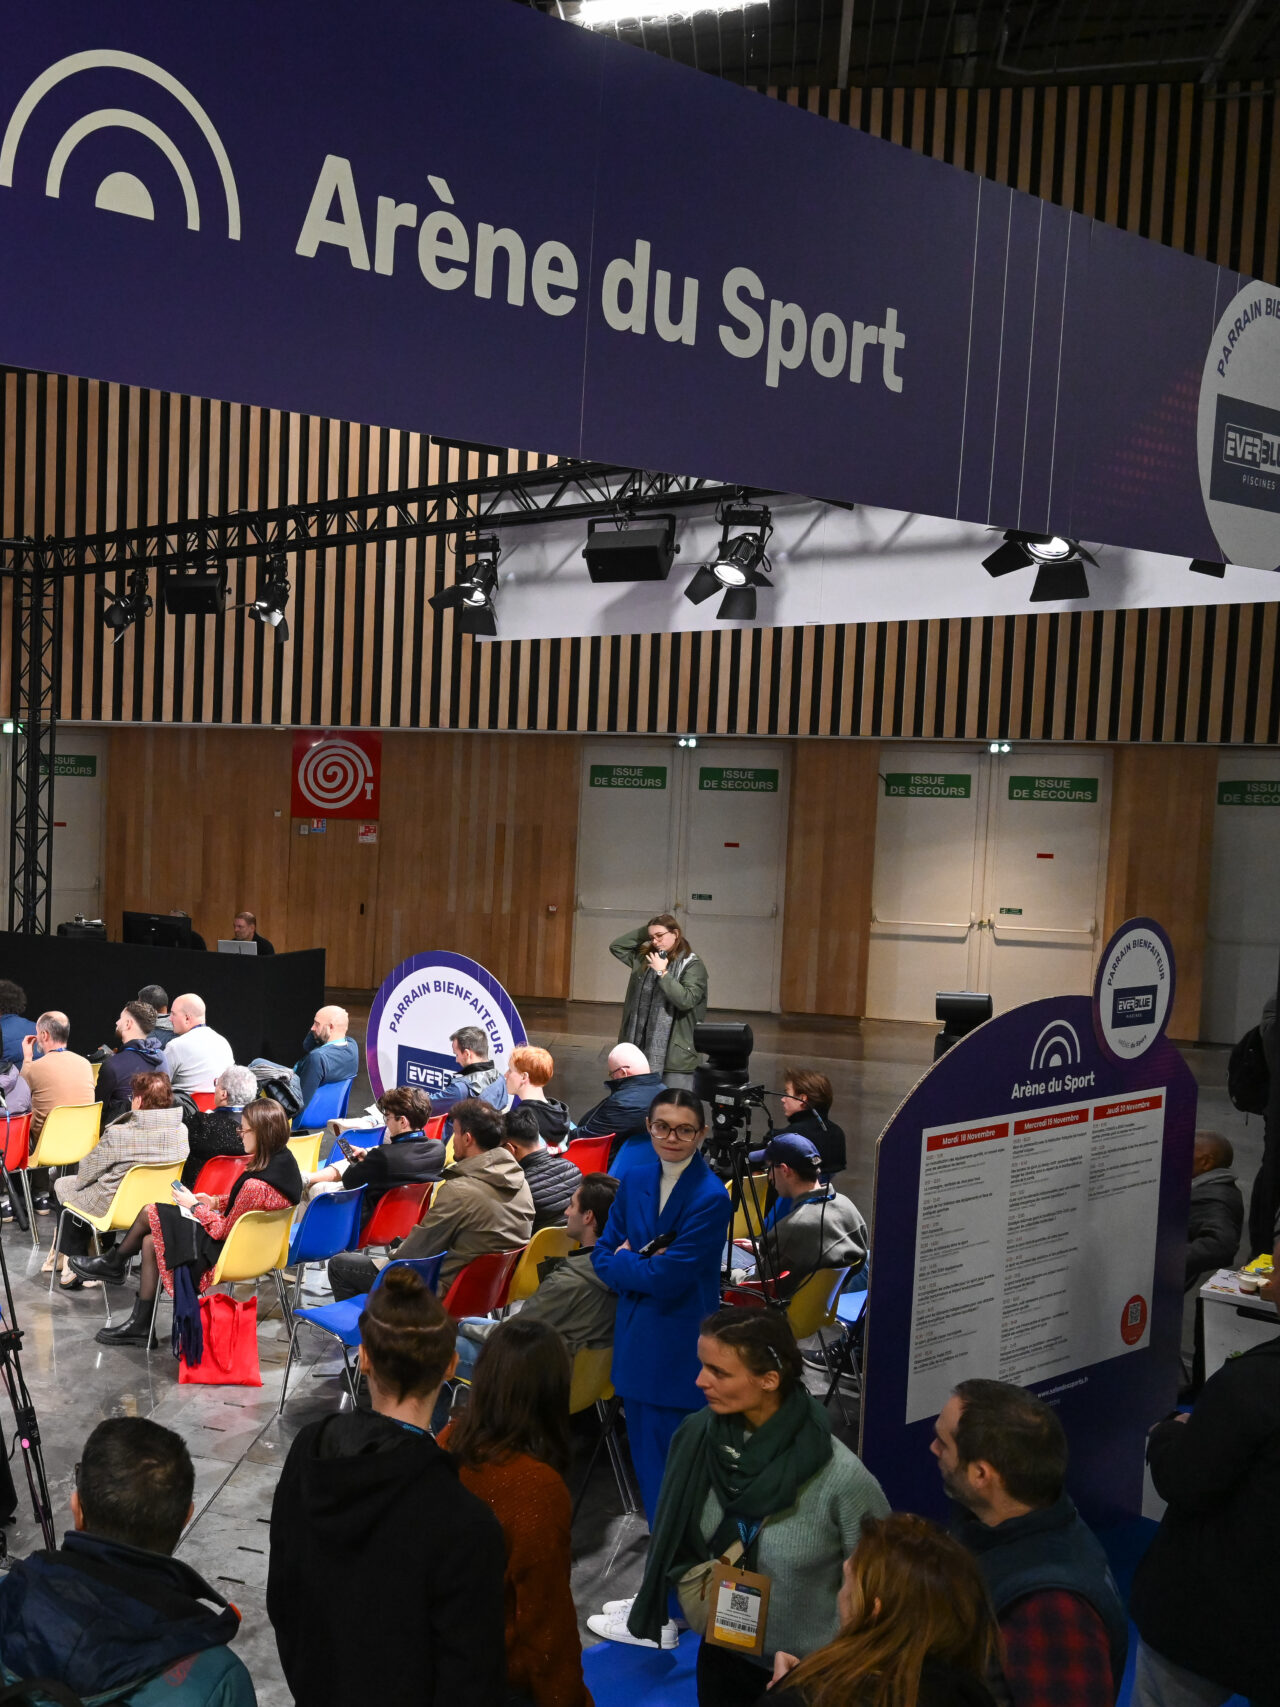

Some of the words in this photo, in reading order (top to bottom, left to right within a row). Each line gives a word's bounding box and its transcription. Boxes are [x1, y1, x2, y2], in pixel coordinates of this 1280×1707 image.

[295, 154, 579, 316] Arène
[602, 239, 699, 345] du
[719, 267, 906, 393] Sport
[1217, 300, 1262, 378] PARRAIN
[1242, 473, 1276, 490] PISCINES
[54, 756, 76, 764] SSUE
[53, 766, 92, 775] ECOURS
[613, 768, 643, 777] ISSUE
[723, 770, 754, 779] ISSUE
[594, 777, 608, 785] DE
[611, 778, 662, 787] SECOURS
[703, 780, 718, 788] DE
[721, 780, 774, 790] SECOURS
[911, 776, 945, 785] ISSUE
[1035, 778, 1071, 788] ISSUE
[890, 786, 905, 794] DE
[908, 787, 965, 796] SECOURS
[1013, 789, 1029, 798] DE
[1032, 790, 1092, 800] SECOURS
[1223, 794, 1241, 803] DE
[1245, 794, 1280, 804] SECO
[1108, 943, 1131, 986] PARRAIN
[1133, 939, 1165, 981] BIENFAITEUR
[389, 982, 431, 1033] PARRAIN
[433, 980, 504, 1055] BIENFAITEUR
[1011, 1080, 1046, 1099] Arène
[1048, 1077, 1062, 1093] du
[1064, 1071, 1095, 1093] Sport
[1126, 1101, 1150, 1111] Novembre
[1024, 1118, 1047, 1130] Mercredi
[1054, 1114, 1079, 1124] Novembre
[942, 1136, 959, 1145] Mardi
[967, 1129, 996, 1140] Novembre
